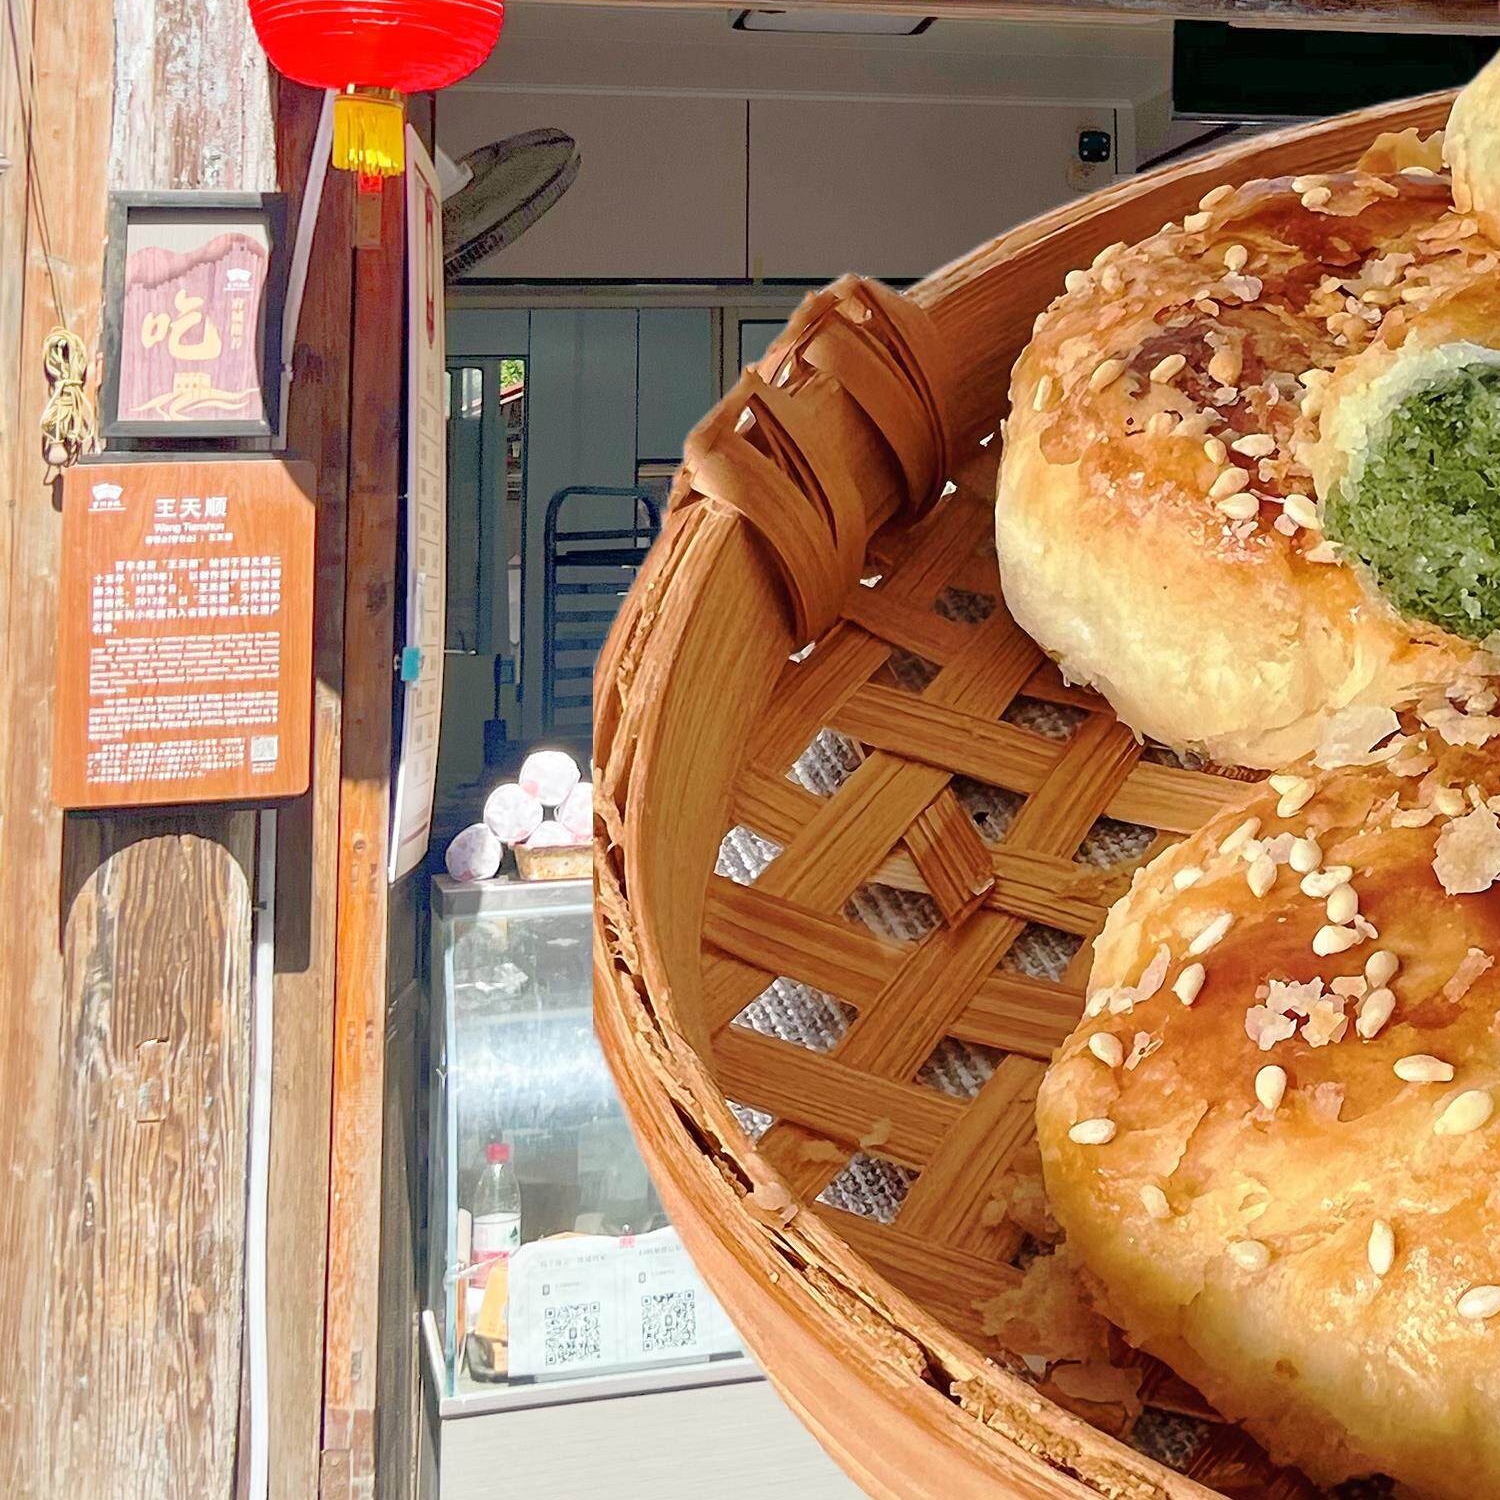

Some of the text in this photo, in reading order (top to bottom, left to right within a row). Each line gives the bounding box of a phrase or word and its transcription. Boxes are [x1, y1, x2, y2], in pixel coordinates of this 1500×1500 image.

[141, 288, 222, 361] 吃
[154, 496, 228, 518] 王天顺
